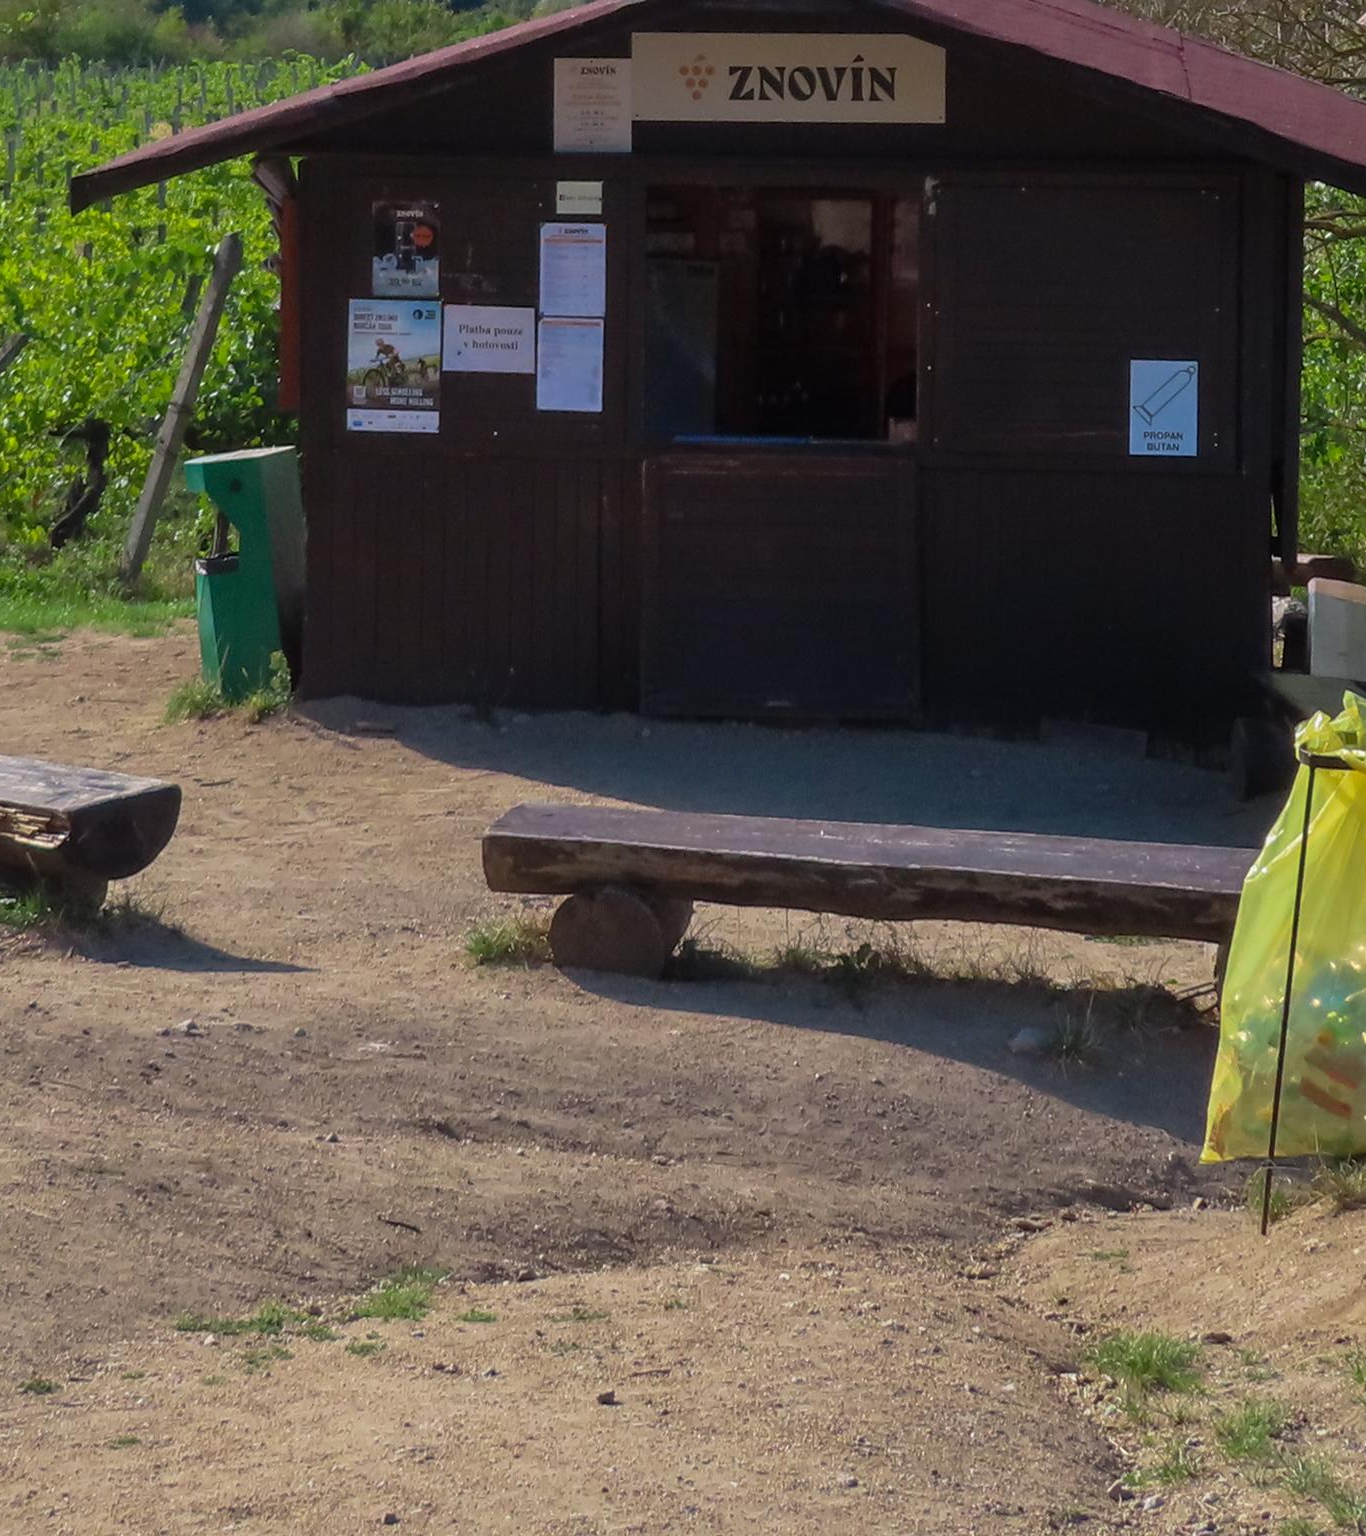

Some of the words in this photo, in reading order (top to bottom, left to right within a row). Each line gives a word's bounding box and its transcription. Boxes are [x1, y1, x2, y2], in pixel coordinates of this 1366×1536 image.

[728, 53, 898, 102] ZNOVÍN
[459, 325, 492, 335] Platba
[494, 328, 524, 338] pouze
[472, 340, 519, 351] hotovosti
[1143, 431, 1184, 441] PROPAN
[1146, 442, 1180, 452] BUTAN
